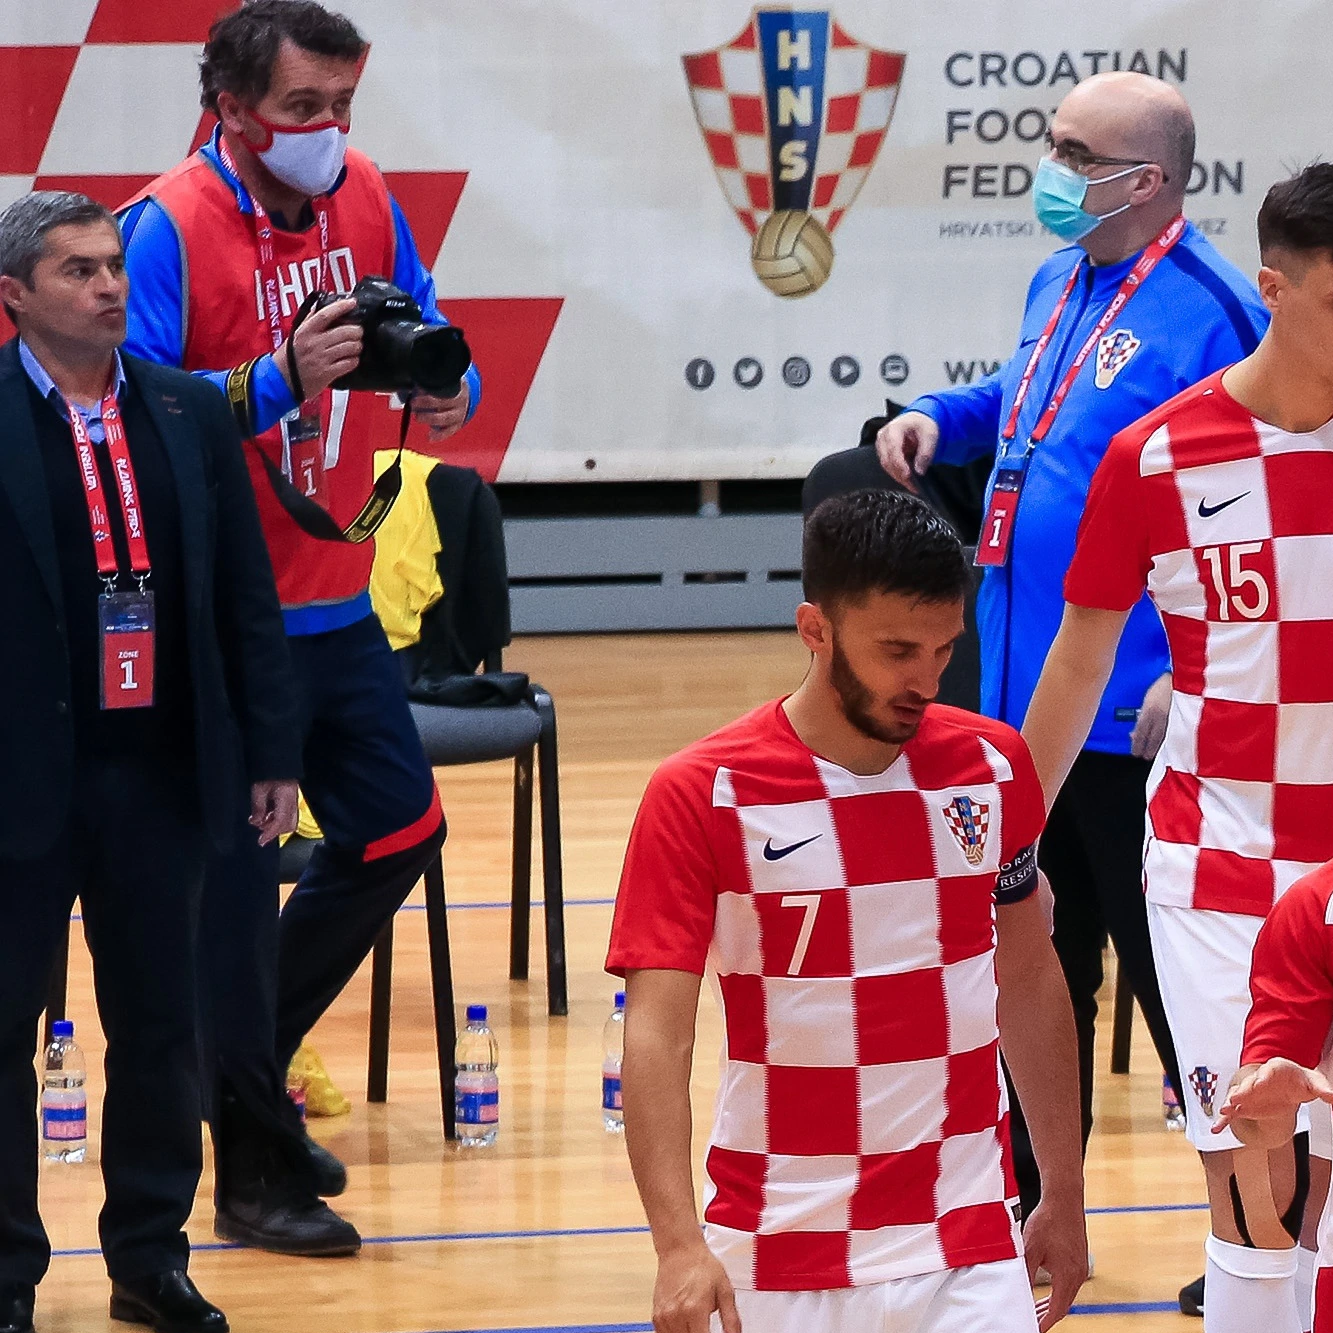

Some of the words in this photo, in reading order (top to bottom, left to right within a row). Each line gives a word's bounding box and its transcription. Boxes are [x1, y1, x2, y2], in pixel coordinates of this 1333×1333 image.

[944, 48, 1189, 87] CROATIAN
[303, 467, 317, 497] 1
[988, 518, 1002, 547] 1
[1202, 542, 1270, 621] 15
[118, 650, 139, 659] ZONE
[120, 660, 138, 690] 1
[780, 894, 822, 976] 7
